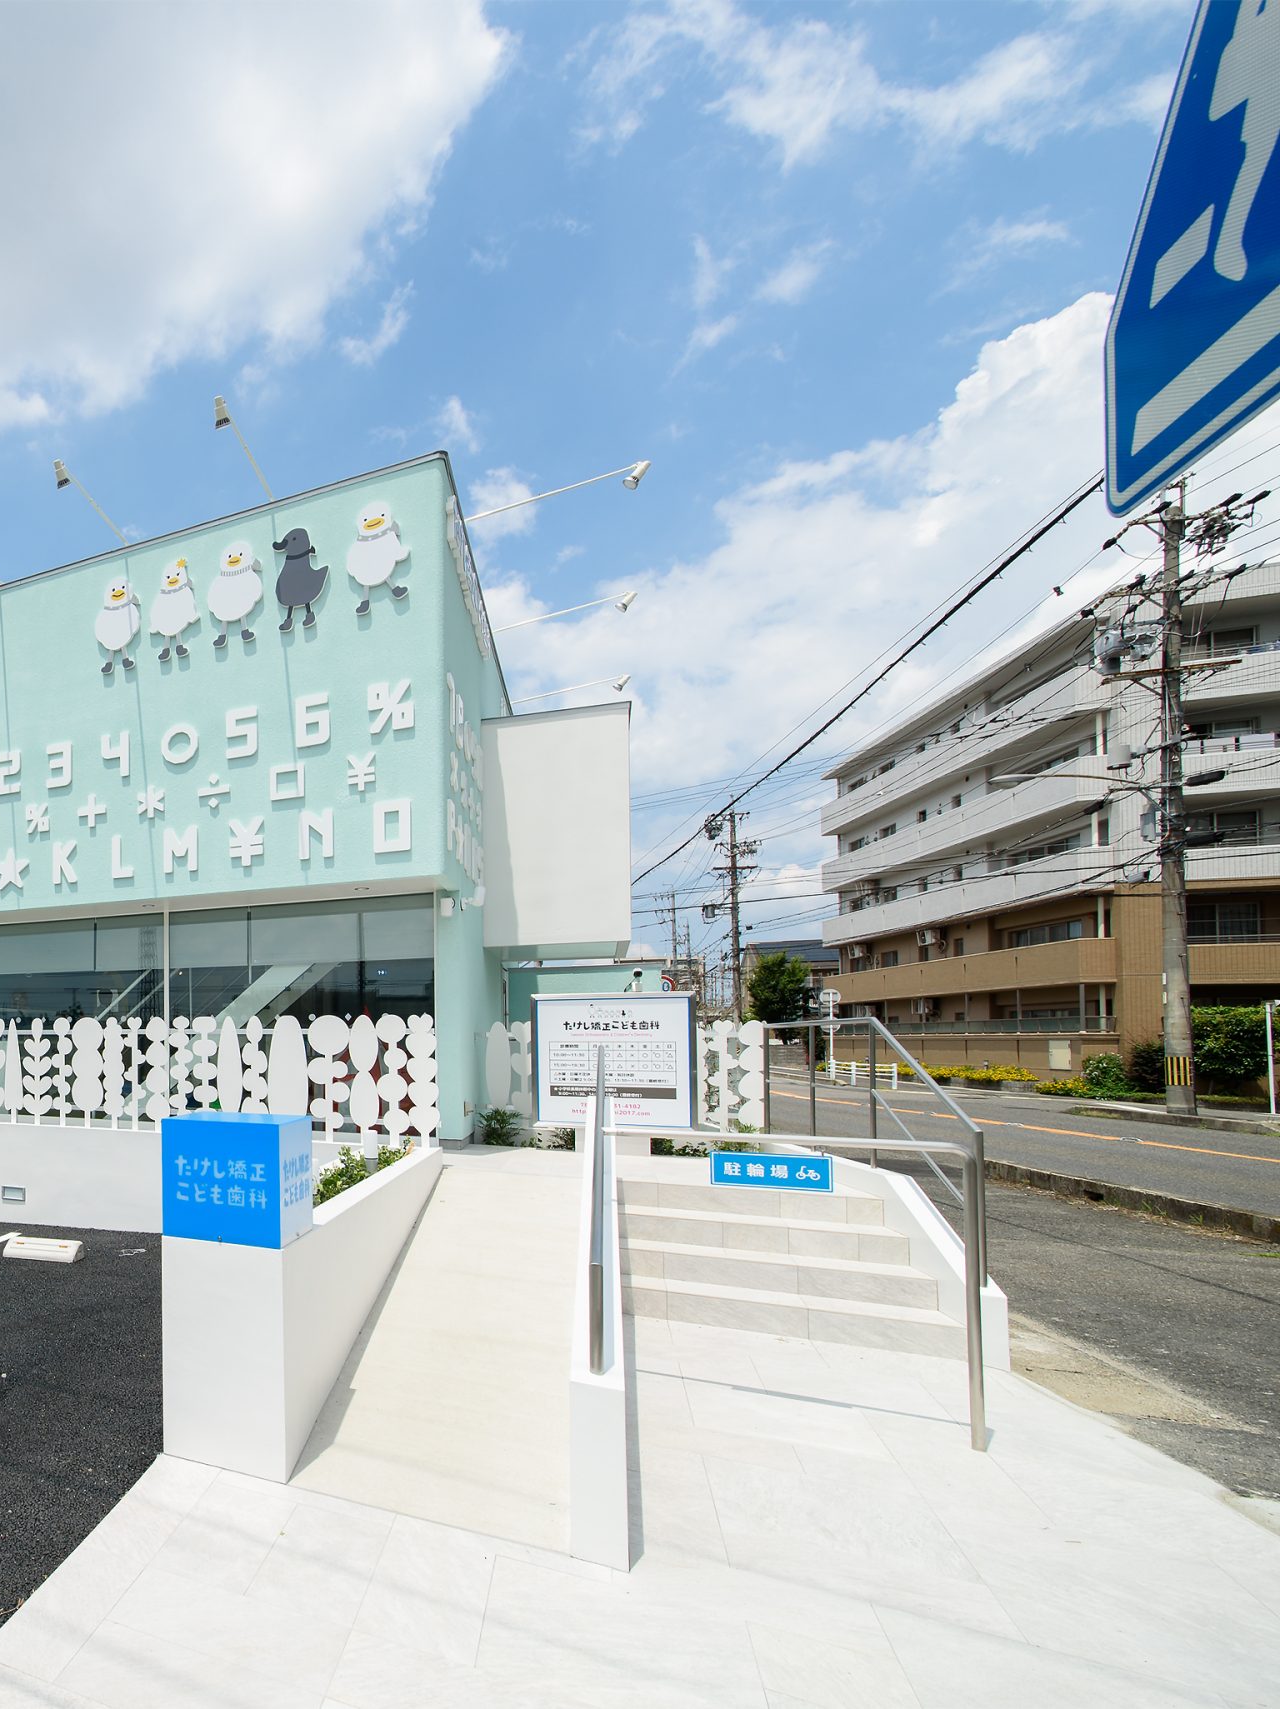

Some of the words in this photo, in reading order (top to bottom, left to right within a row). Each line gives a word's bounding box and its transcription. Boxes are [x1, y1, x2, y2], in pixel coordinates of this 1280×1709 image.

[563, 1020, 660, 1031] たけし矯正こども歯科
[174, 1154, 267, 1182] たけし矯正
[723, 1161, 789, 1179] 駐輪場
[176, 1182, 268, 1209] こども歯科
